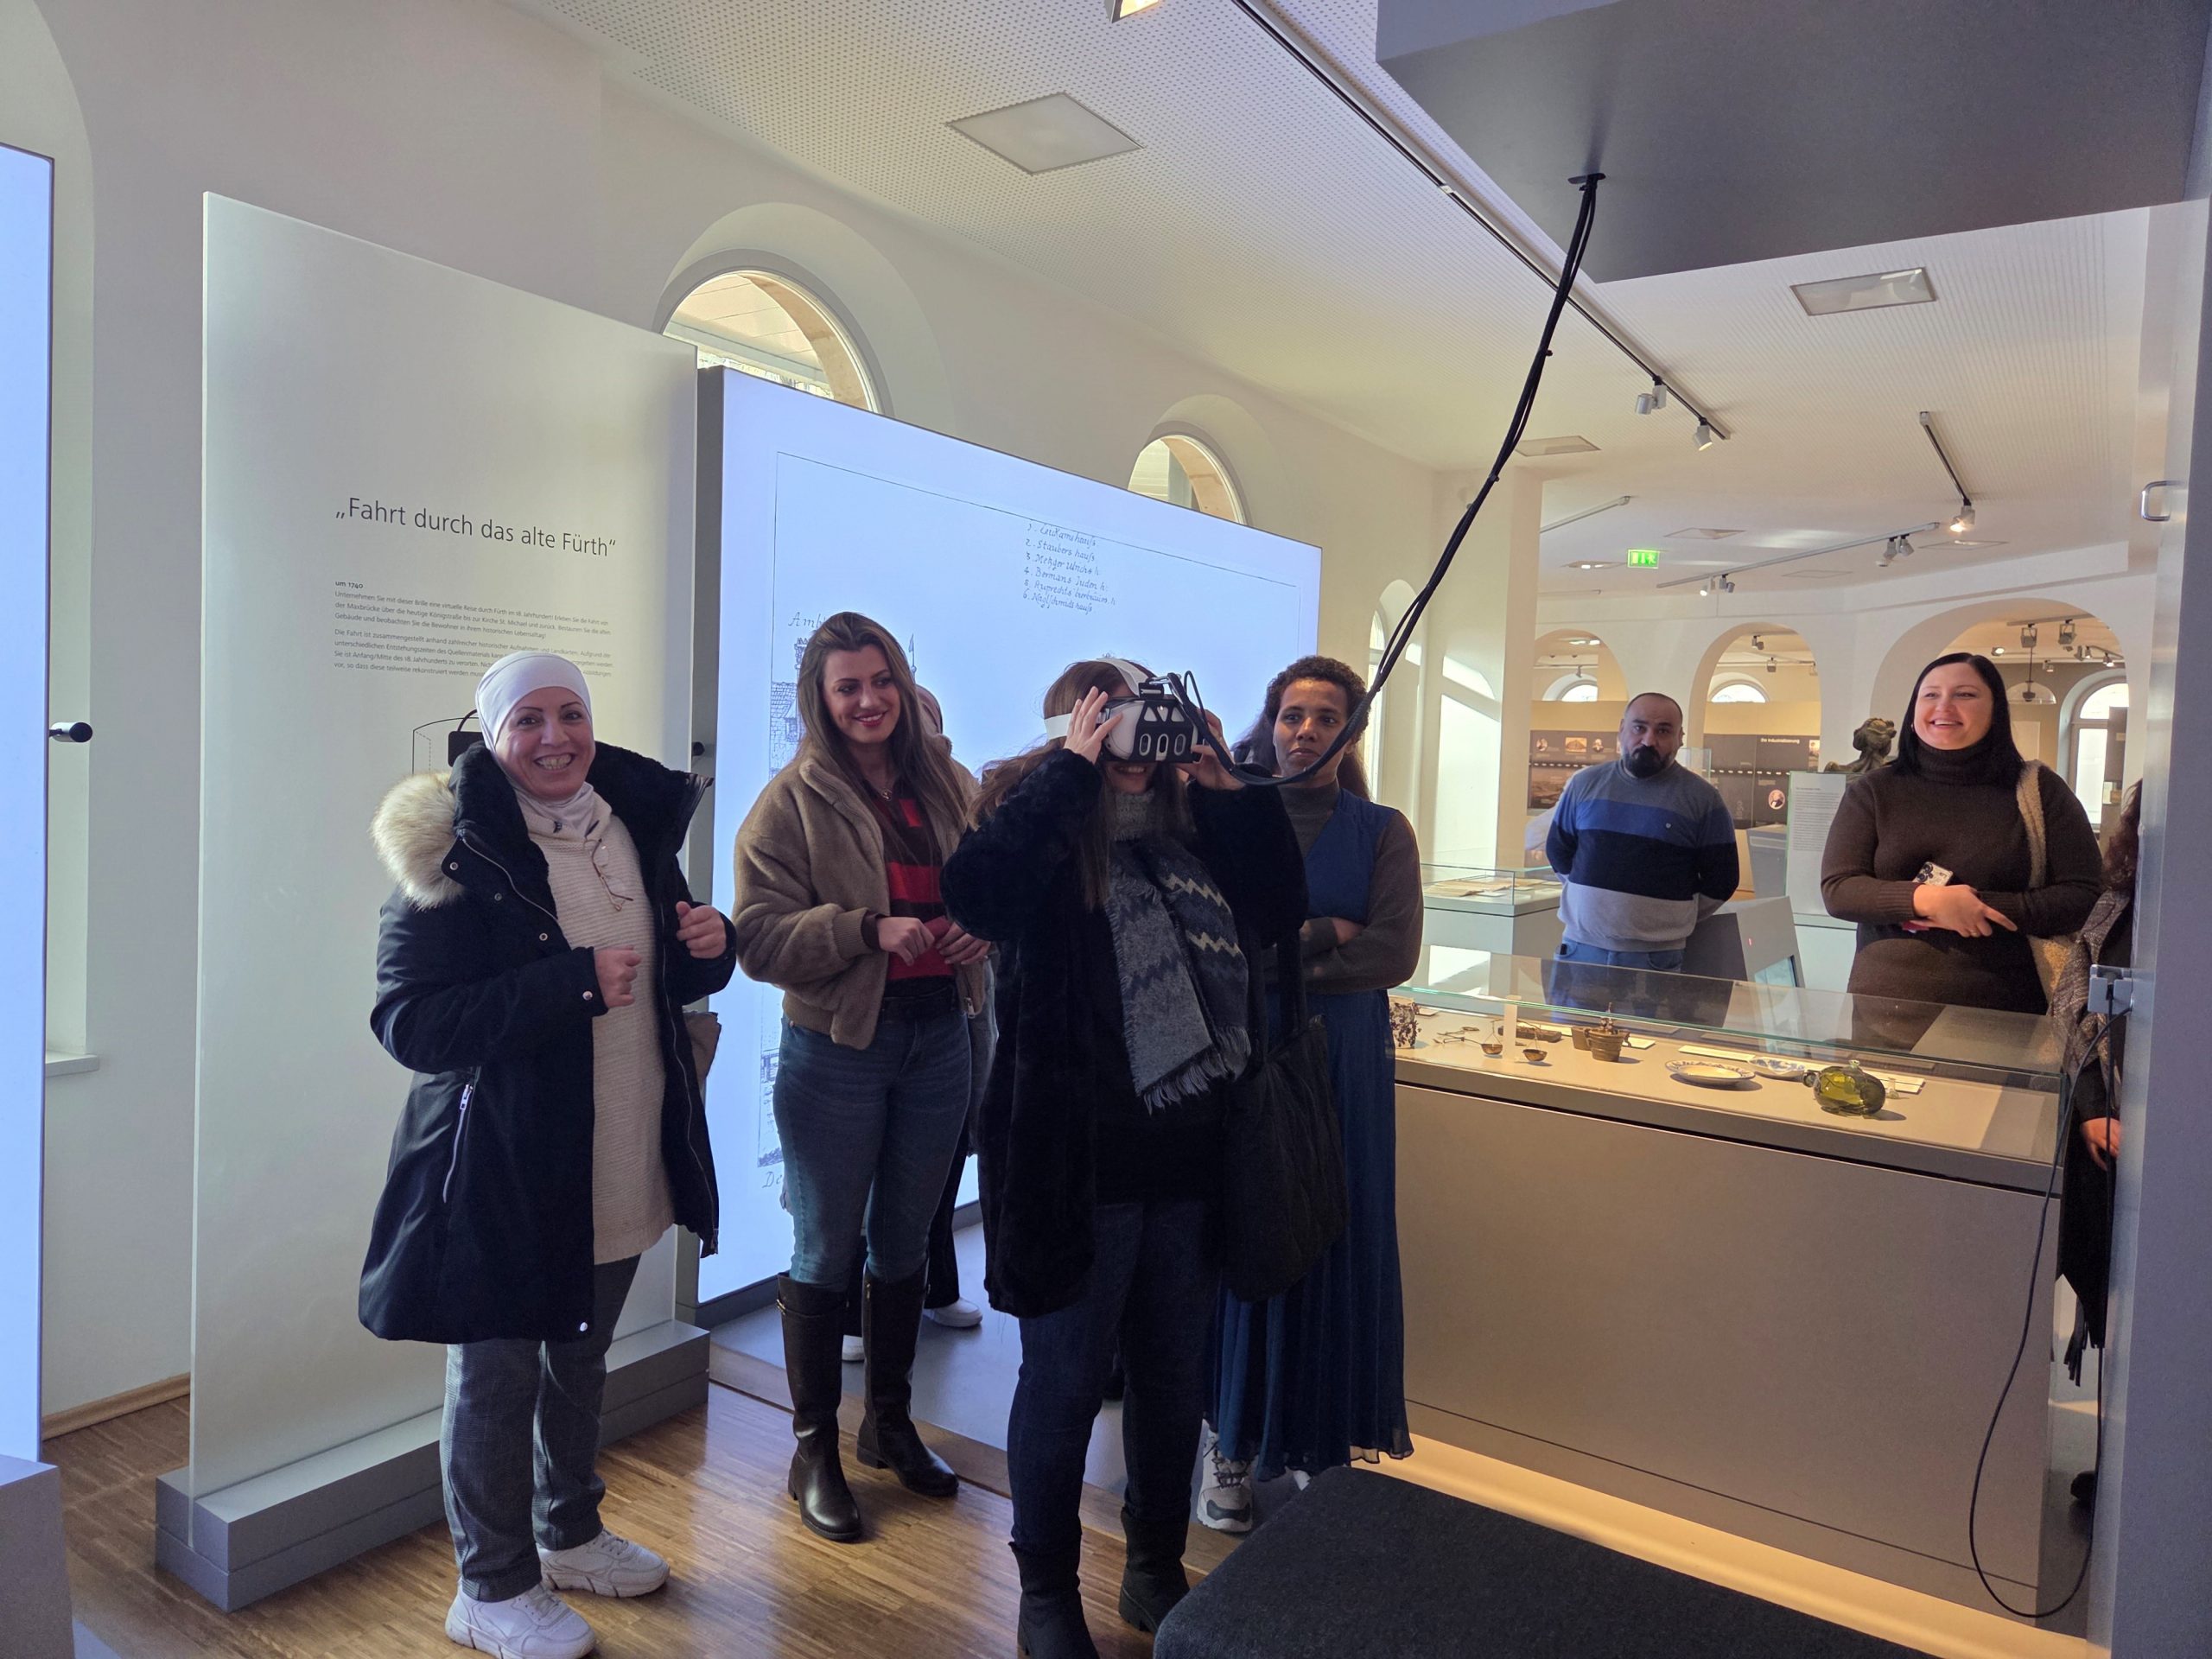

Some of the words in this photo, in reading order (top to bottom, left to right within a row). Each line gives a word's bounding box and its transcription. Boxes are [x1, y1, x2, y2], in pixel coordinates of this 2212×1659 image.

[336, 498, 405, 525] „Fahrt
[414, 508, 473, 535] durch
[481, 519, 514, 542] das
[522, 526, 556, 549] alte
[563, 533, 616, 556] Fürth“
[335, 590, 375, 601] Unternehmen
[397, 596, 413, 605] dieser
[415, 598, 428, 607] Brille
[494, 607, 507, 615] Fürth
[555, 613, 571, 622] Erleben
[335, 612, 362, 620] Gebäude
[377, 616, 410, 626] beobachten
[431, 620, 458, 630] Bewohner
[483, 626, 512, 635] historischen
[347, 602, 380, 612] Maxbrücke
[407, 608, 428, 619] heutige
[429, 611, 462, 620] Königstraße
[482, 615, 498, 624] Kirche
[507, 619, 527, 627] Michael
[558, 624, 582, 632] Bestaunen
[334, 639, 385, 649] unterschiedlichen
[386, 643, 436, 653] Entstehungszeiten
[448, 648, 490, 658] Quellenmaterials
[373, 633, 424, 642] zusammengestellt
[479, 640, 508, 650] historischer
[353, 651, 392, 661] Anfang/Mitte
[413, 655, 448, 664] Jahrhunderts
[412, 666, 448, 675] rekonstruiert
